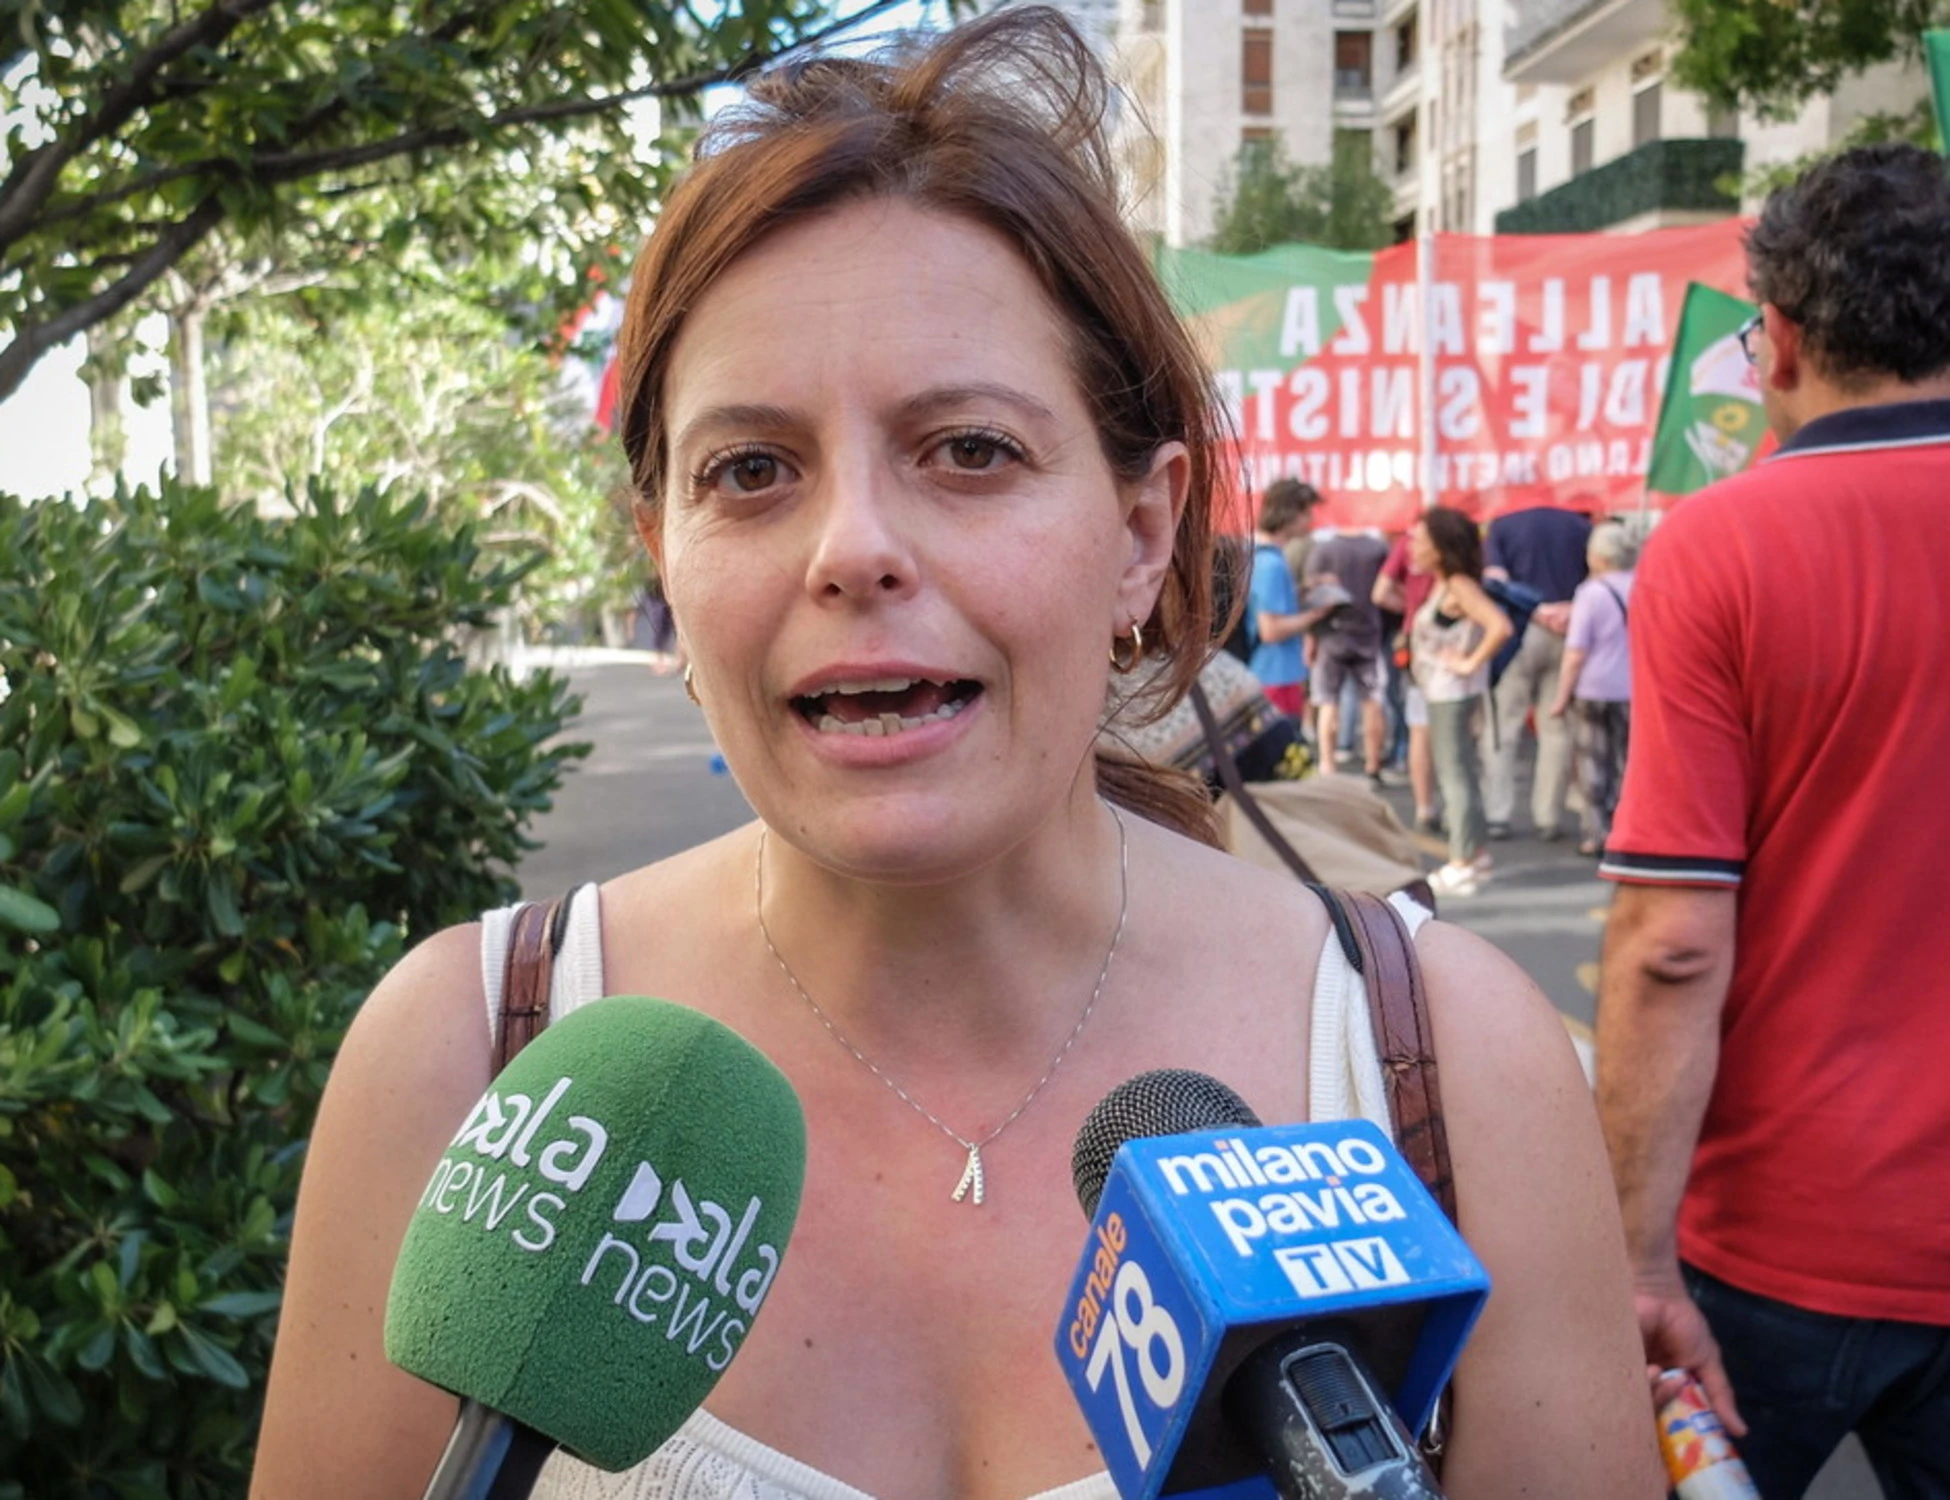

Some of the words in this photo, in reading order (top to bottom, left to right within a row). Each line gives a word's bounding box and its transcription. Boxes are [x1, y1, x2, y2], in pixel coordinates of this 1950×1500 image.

[418, 1158, 567, 1251] news
[1156, 1137, 1387, 1196] milano
[1208, 1175, 1407, 1258] pavia
[581, 1232, 746, 1371] news
[1070, 1211, 1127, 1359] canale
[1283, 1240, 1390, 1292] TV
[1085, 1260, 1186, 1472] 78
